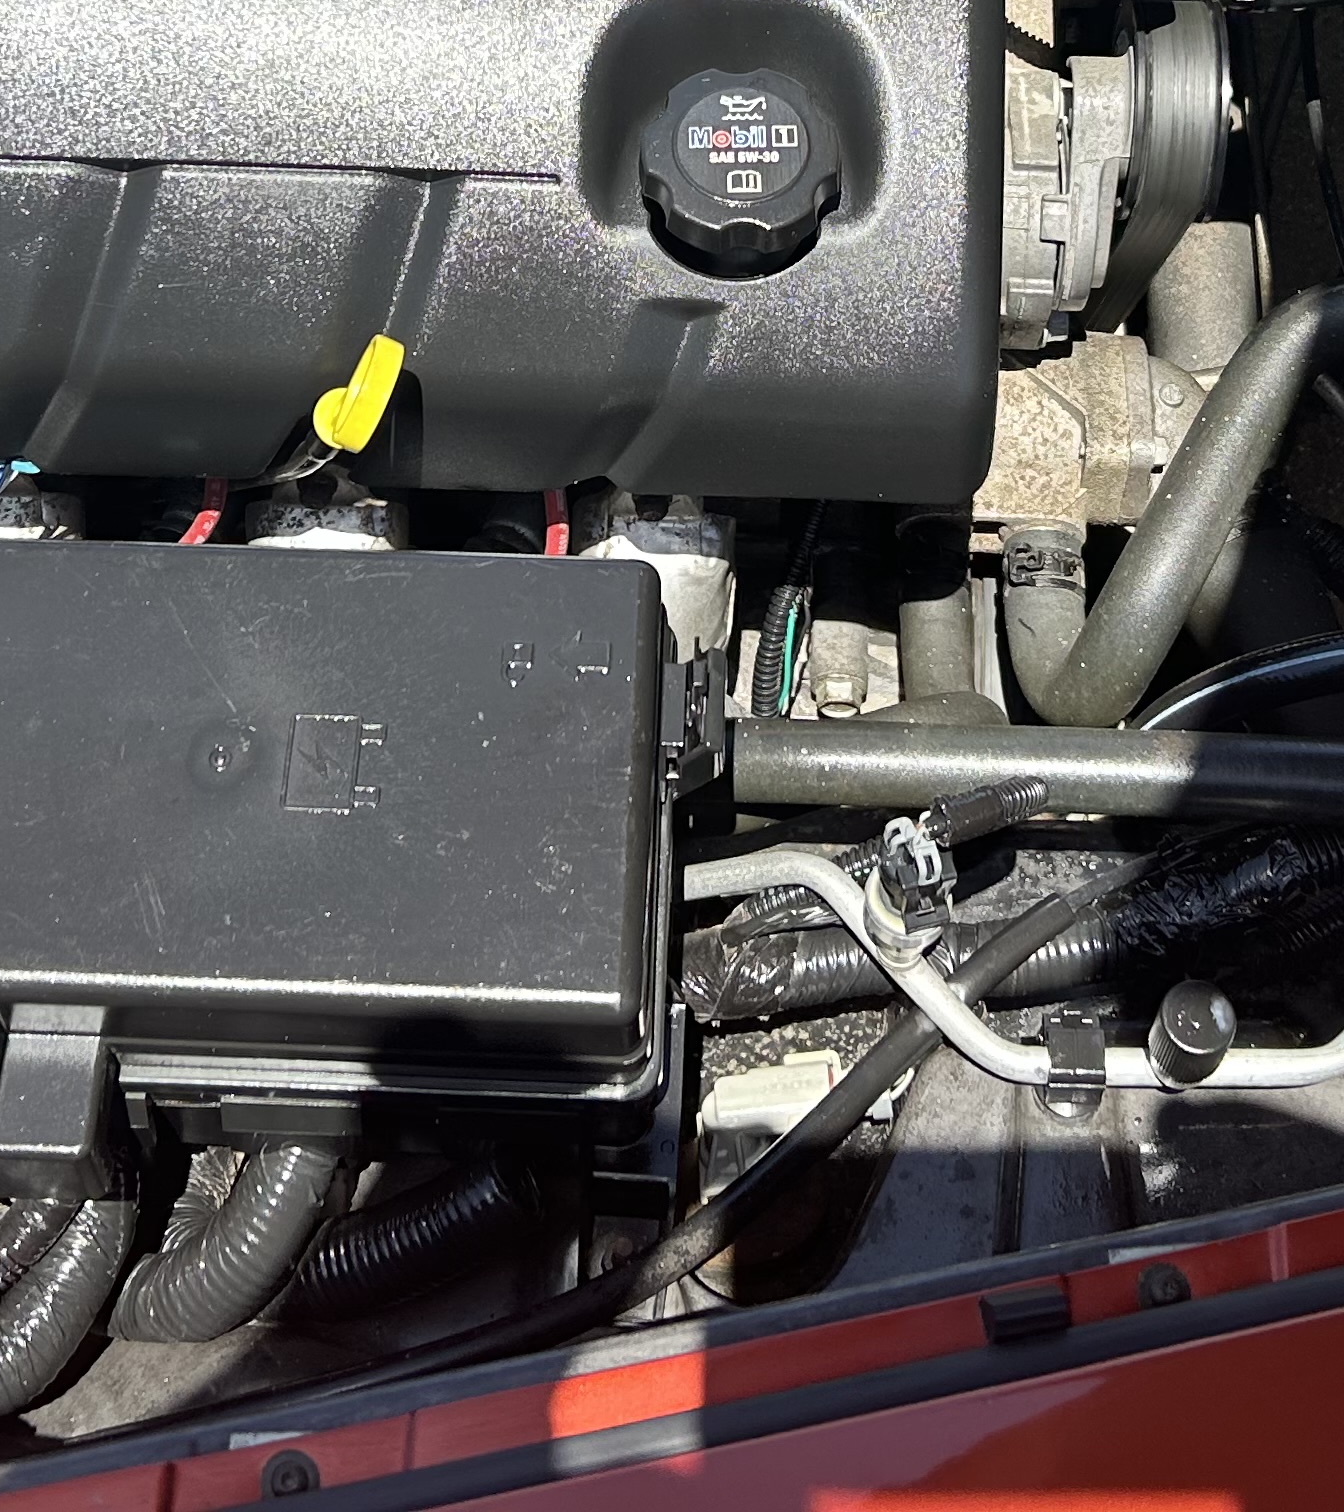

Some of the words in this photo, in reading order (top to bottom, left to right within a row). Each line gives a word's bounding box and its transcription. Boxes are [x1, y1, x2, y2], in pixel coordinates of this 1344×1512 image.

[688, 126, 766, 148] Mobil
[709, 151, 735, 163] SAE
[738, 151, 780, 163] 5W-30
